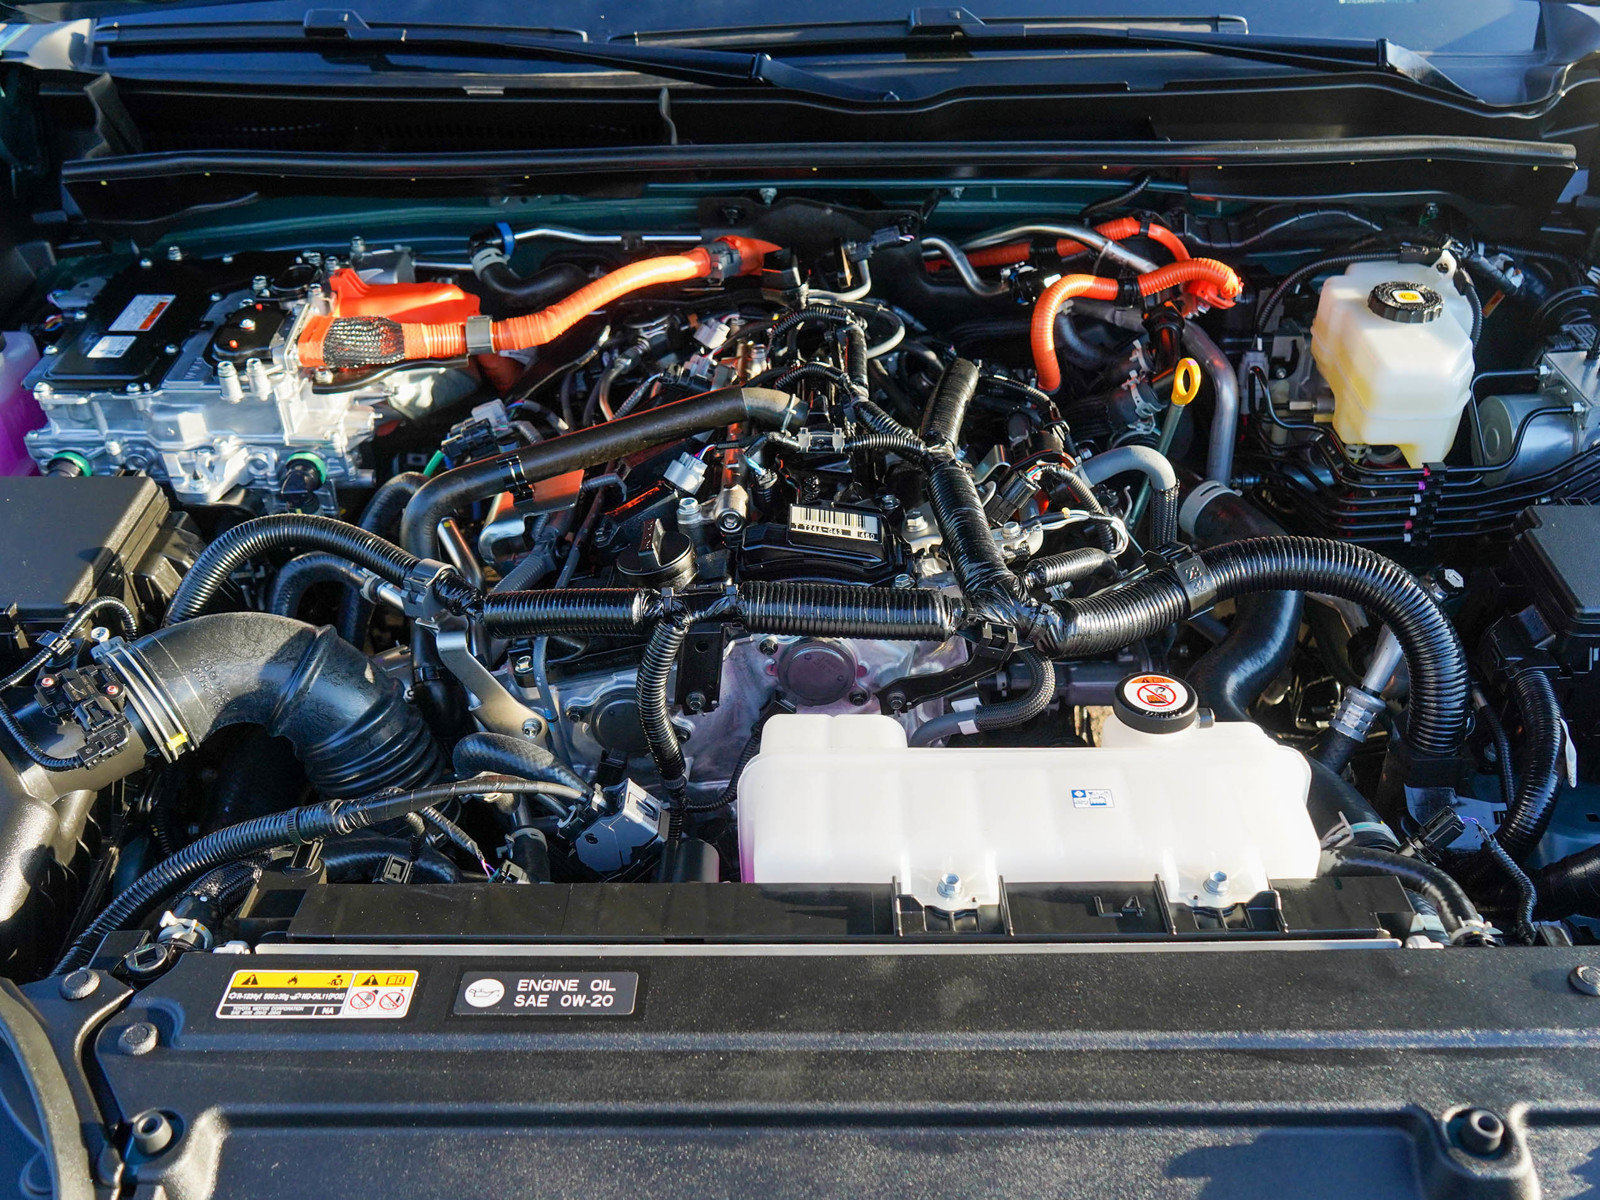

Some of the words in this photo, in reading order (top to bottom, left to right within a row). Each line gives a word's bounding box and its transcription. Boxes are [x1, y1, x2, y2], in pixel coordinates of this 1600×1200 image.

[1093, 895, 1145, 917] L4
[517, 979, 580, 992] ENGINE
[590, 979, 617, 992] OIL
[513, 994, 550, 1007] SAE
[560, 994, 614, 1007] 0W-20
